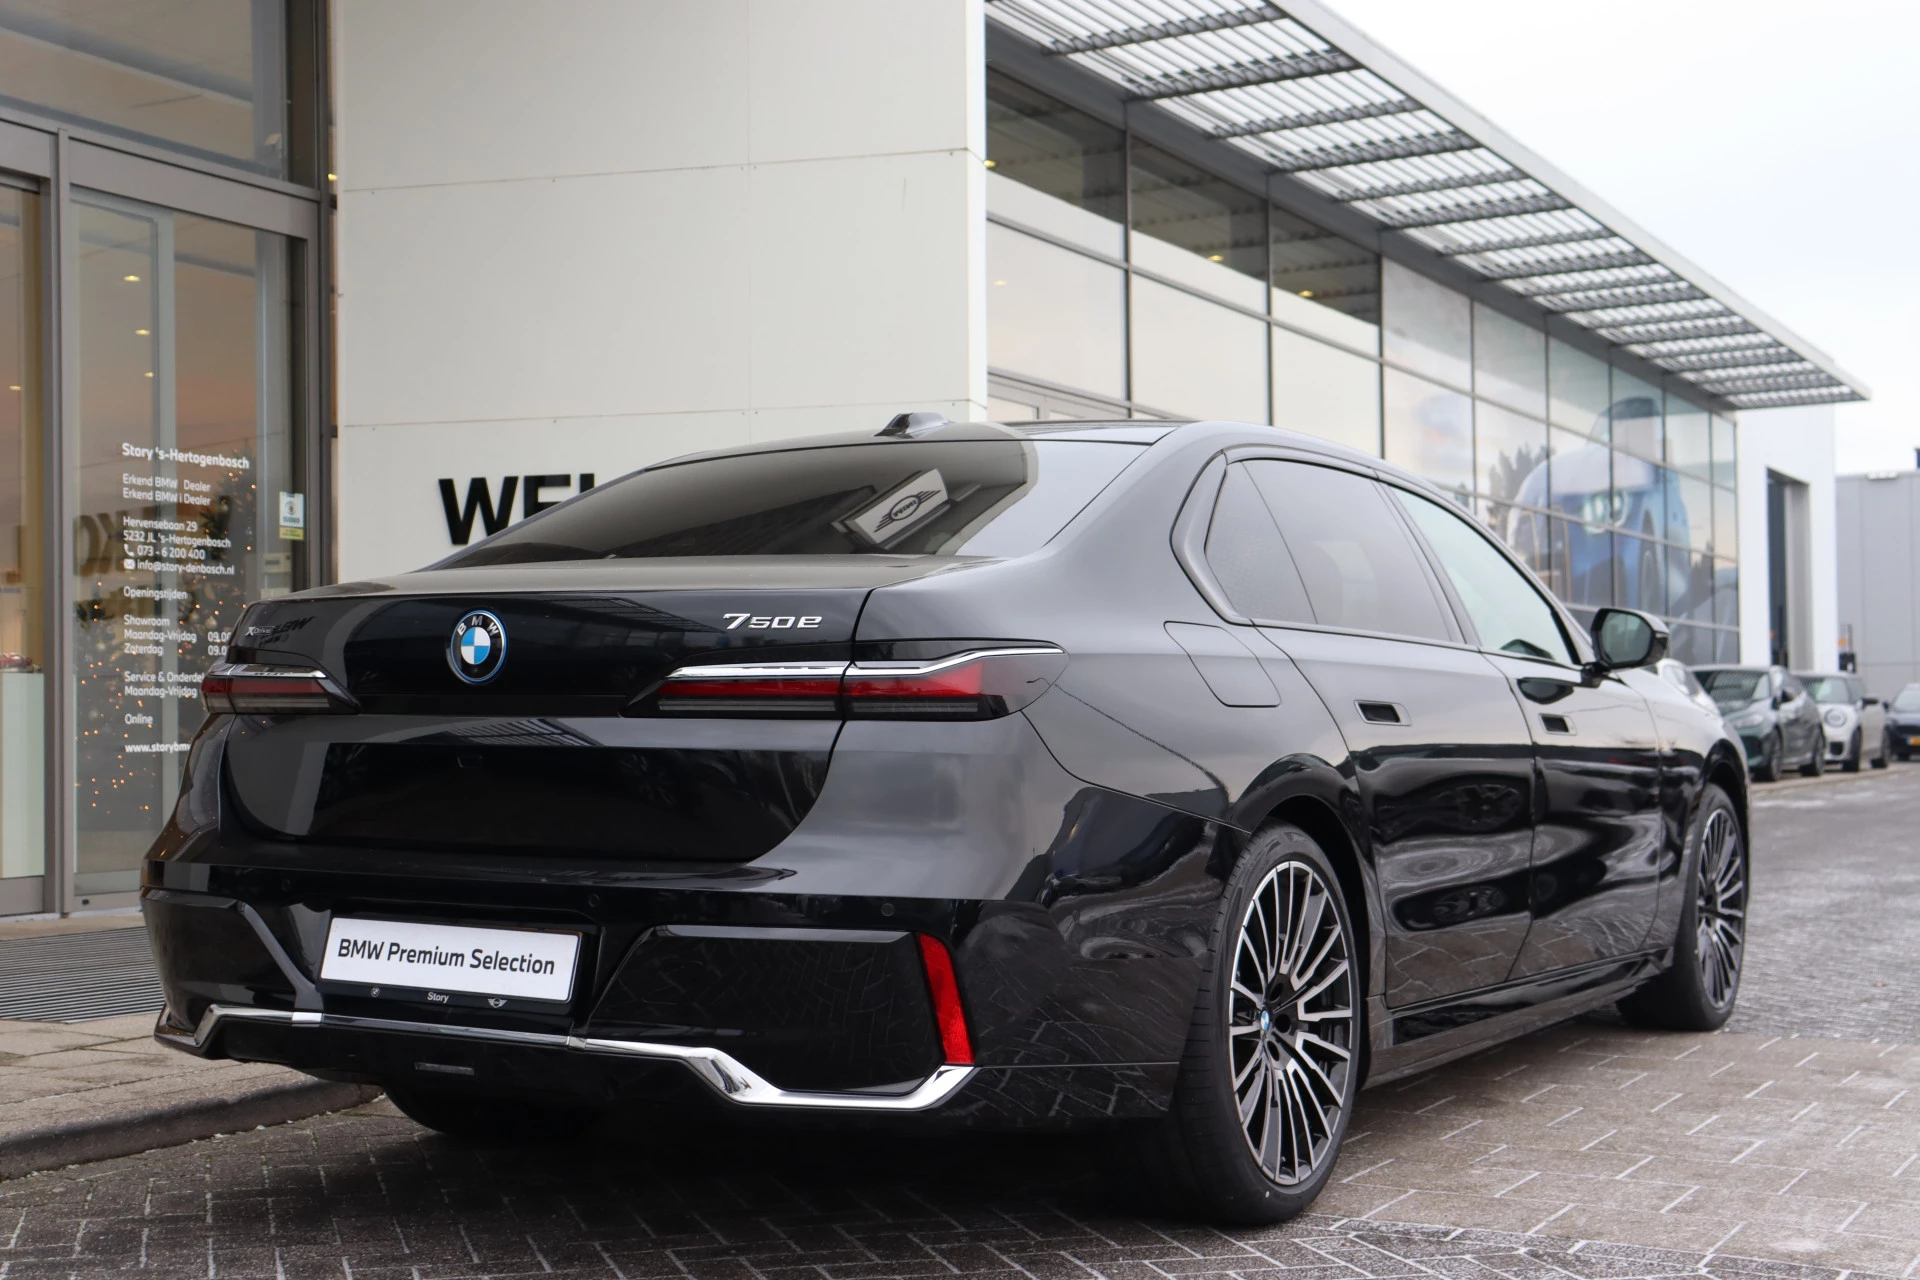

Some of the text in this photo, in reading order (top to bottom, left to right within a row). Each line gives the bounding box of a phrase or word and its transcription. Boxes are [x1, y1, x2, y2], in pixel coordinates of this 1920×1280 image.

[122, 442, 250, 469] Story 's-Hertogenbosch
[122, 473, 212, 492] Erkend BMW Dealer
[122, 487, 153, 501] Erkend
[154, 490, 178, 503] BMW
[183, 493, 211, 506] Dealer
[438, 473, 595, 545] WE
[123, 516, 198, 532] Hervensebaan 29
[123, 530, 232, 548] 5232 JL 's-Hertogenbosch
[137, 545, 154, 557] 073
[161, 547, 168, 557] 6
[169, 547, 187, 559] 200
[188, 548, 206, 560] 400
[137, 559, 236, 576] info@story-denbosch.nl
[123, 586, 189, 601] Openingstijden
[123, 614, 170, 626] Showroom
[457, 615, 499, 636] BMW
[124, 629, 198, 644] Maandag-Vrijdag
[124, 643, 164, 657] Zaterdag
[124, 671, 156, 683] Service
[157, 671, 166, 683] &
[124, 685, 198, 699] Maandag-Vrijdag
[124, 713, 153, 725] Online
[338, 938, 555, 975] BMW Premium Selection
[427, 991, 449, 1004] Story
